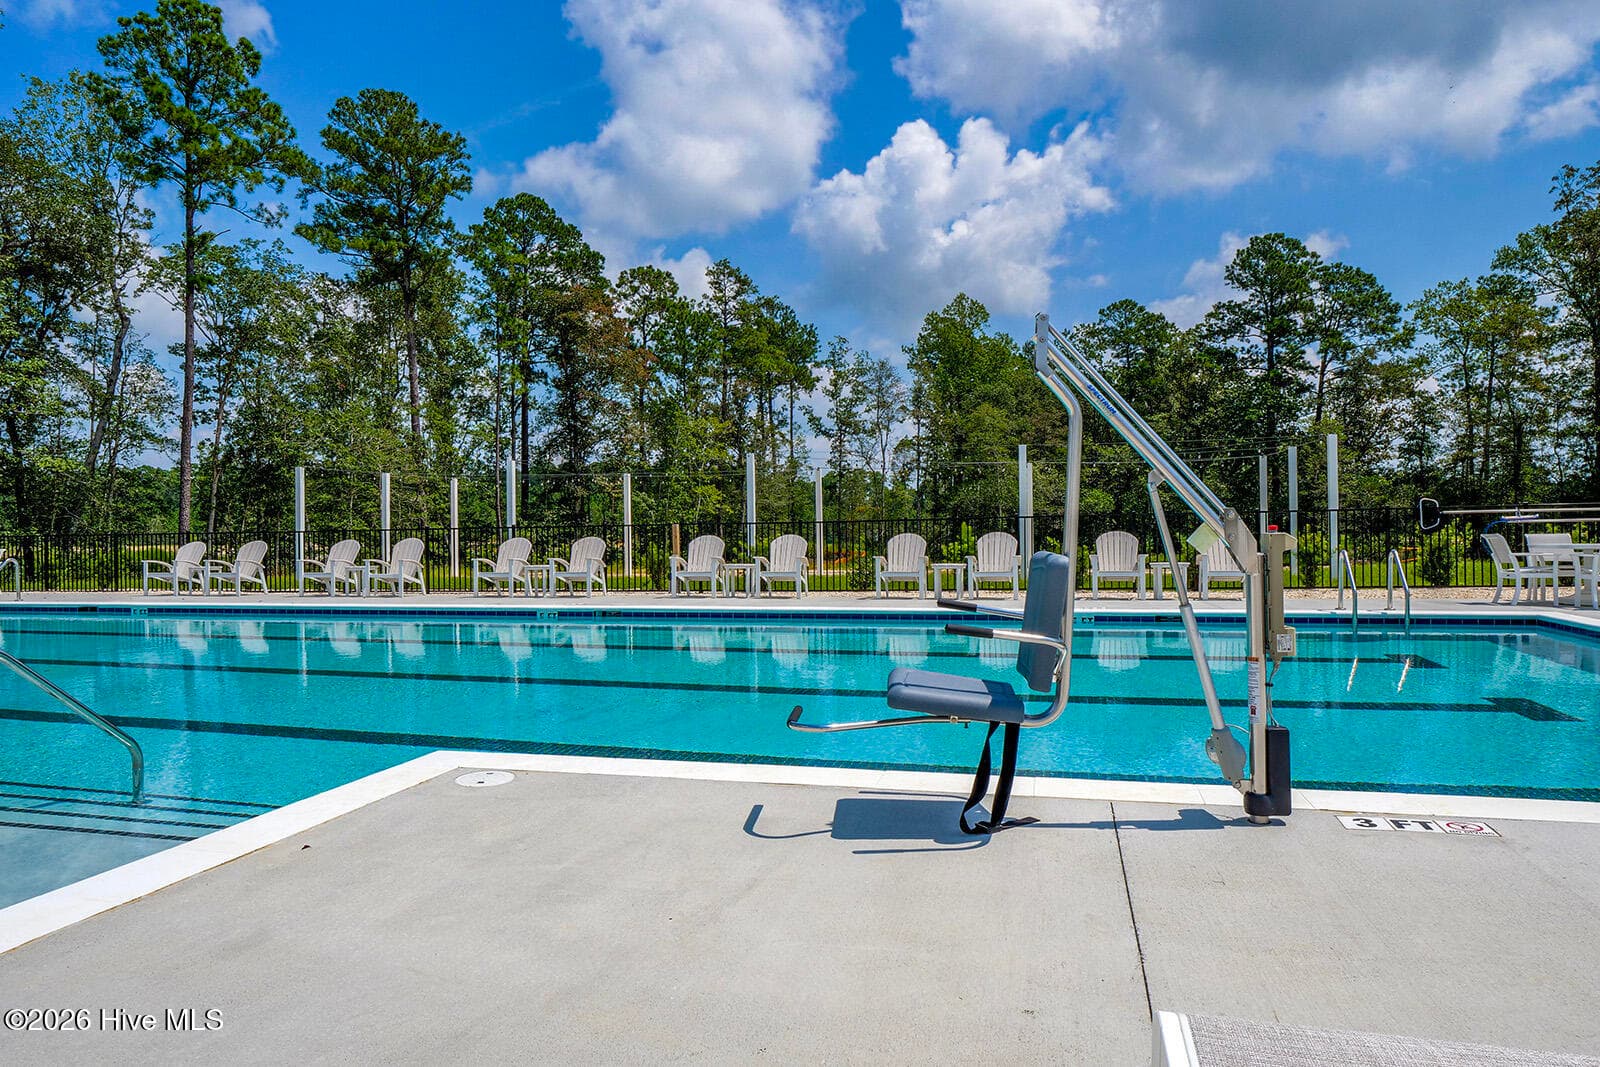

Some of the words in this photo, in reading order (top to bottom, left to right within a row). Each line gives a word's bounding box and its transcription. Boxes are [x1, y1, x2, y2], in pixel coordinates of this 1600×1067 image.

[1087, 383, 1117, 415] SPECTRUM
[1352, 817, 1378, 828] 3
[1389, 819, 1434, 831] FT
